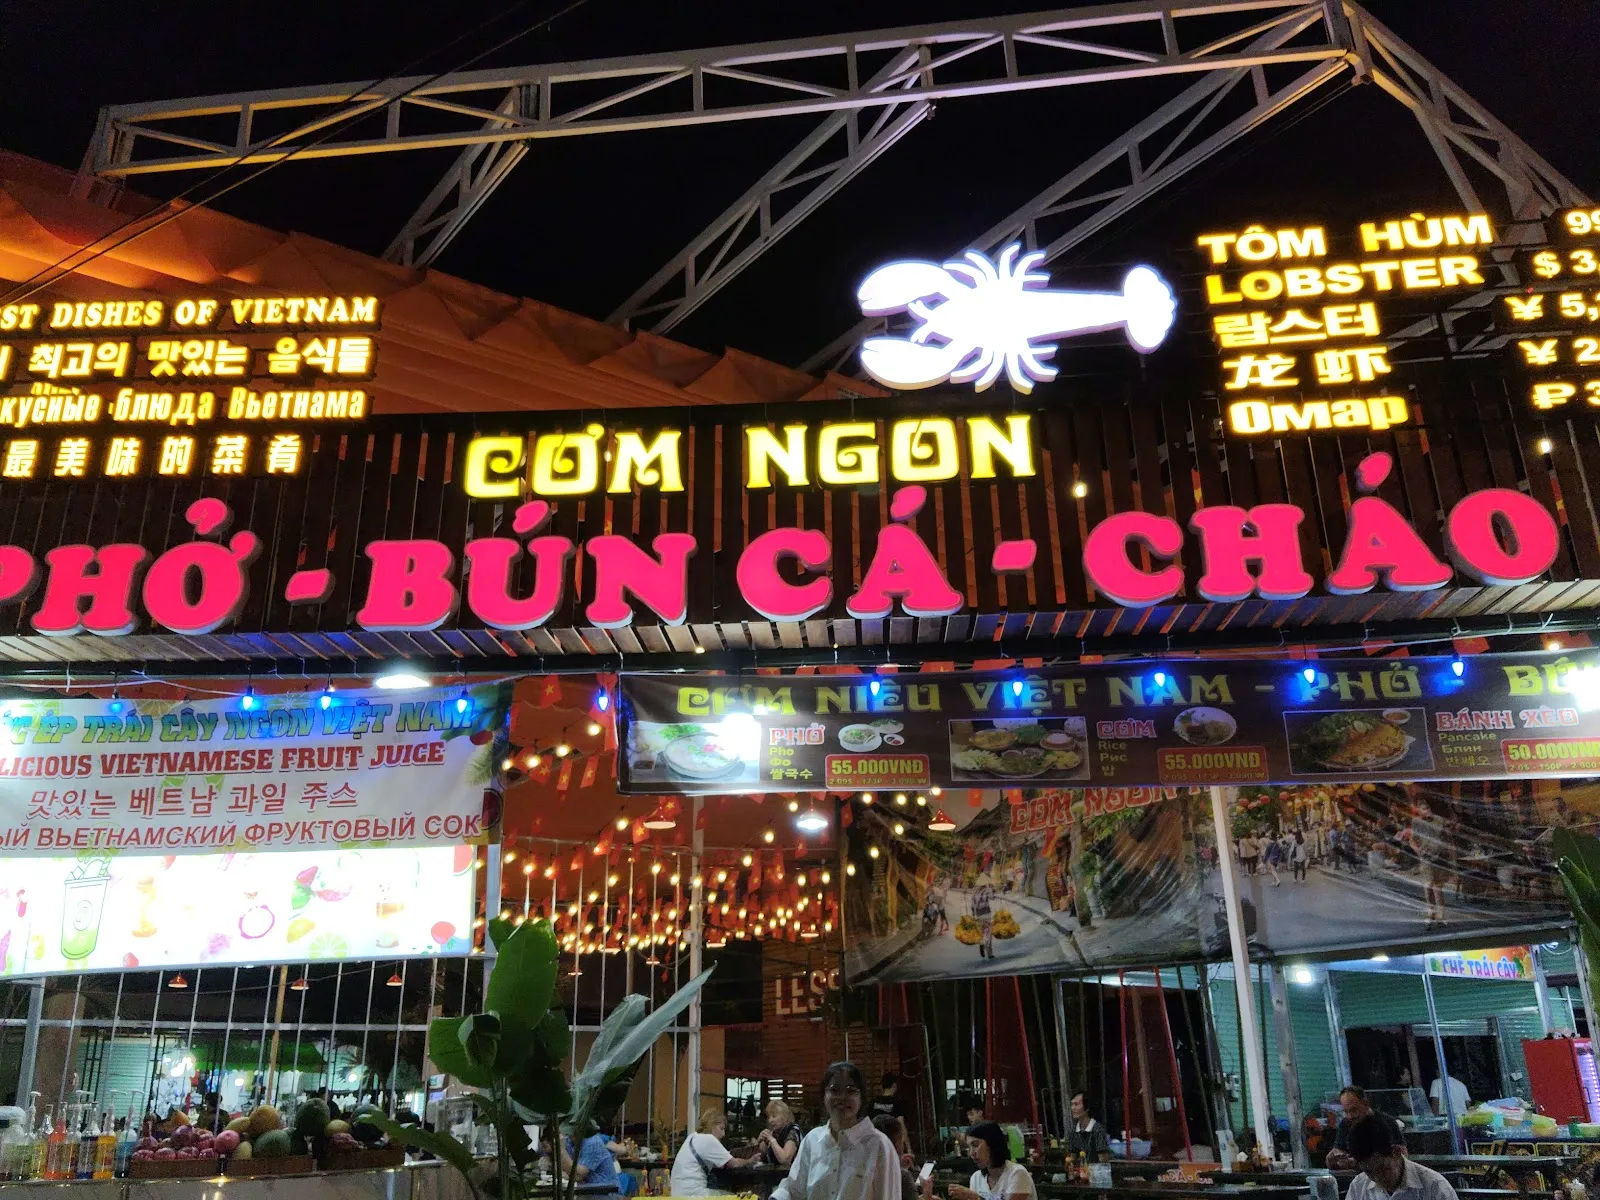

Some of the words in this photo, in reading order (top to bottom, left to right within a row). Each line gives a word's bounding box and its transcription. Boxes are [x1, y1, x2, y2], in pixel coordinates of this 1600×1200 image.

[1198, 225, 1328, 264] TÔM
[1359, 212, 1493, 252] HÙM
[1206, 256, 1486, 305] LOBSTER
[50, 300, 164, 328] DISHES
[175, 300, 219, 326] OF
[231, 297, 377, 324] VIETNAM
[1213, 301, 1380, 348] 랍스터
[28, 342, 131, 379] 최고의
[148, 340, 248, 377] 맛있는
[268, 336, 371, 374] 음식들
[1222, 346, 1392, 390] 龙虾
[113, 387, 215, 426] блюда
[228, 386, 367, 420] Вьетнама
[1229, 396, 1408, 434] Омар
[3, 433, 301, 479] 最美味的菜肴
[464, 423, 684, 498] CƠM
[745, 414, 1035, 489] NGON
[356, 499, 697, 632] BÚN
[736, 485, 965, 622] CÁ
[1082, 451, 1560, 608] CHÁO
[814, 678, 943, 714] NIÊU
[960, 674, 1087, 716] VIỆT
[1105, 674, 1236, 707] NAM
[1294, 661, 1423, 702] PHỞ
[82, 708, 154, 744] TRÁI
[160, 706, 219, 743] CÂY
[223, 707, 316, 741] NGON
[322, 698, 394, 740] VIỆT
[396, 698, 476, 732] NAM
[769, 722, 826, 746] PHỞ
[1435, 707, 1516, 731] BÁNH
[1439, 731, 1497, 742] Pancake
[100, 747, 273, 776] VIETNAMESE
[281, 746, 364, 771] FRUIT
[369, 741, 446, 767] JUICE
[768, 746, 795, 757] Pho
[1098, 740, 1128, 751] Rice
[1164, 752, 1261, 771] 55.000VNĐ
[769, 768, 814, 780] 쌀국수
[831, 759, 924, 776] 55.000VNĐ
[28, 788, 117, 817] 맛있는
[128, 783, 217, 816] 베트남
[228, 782, 287, 814] 과일
[301, 781, 358, 810] 주스
[37, 819, 237, 848] ВЬЕТНАМСКИЙ
[245, 811, 417, 842] ФРУКТОВЫЙ
[423, 814, 481, 837] СОК
